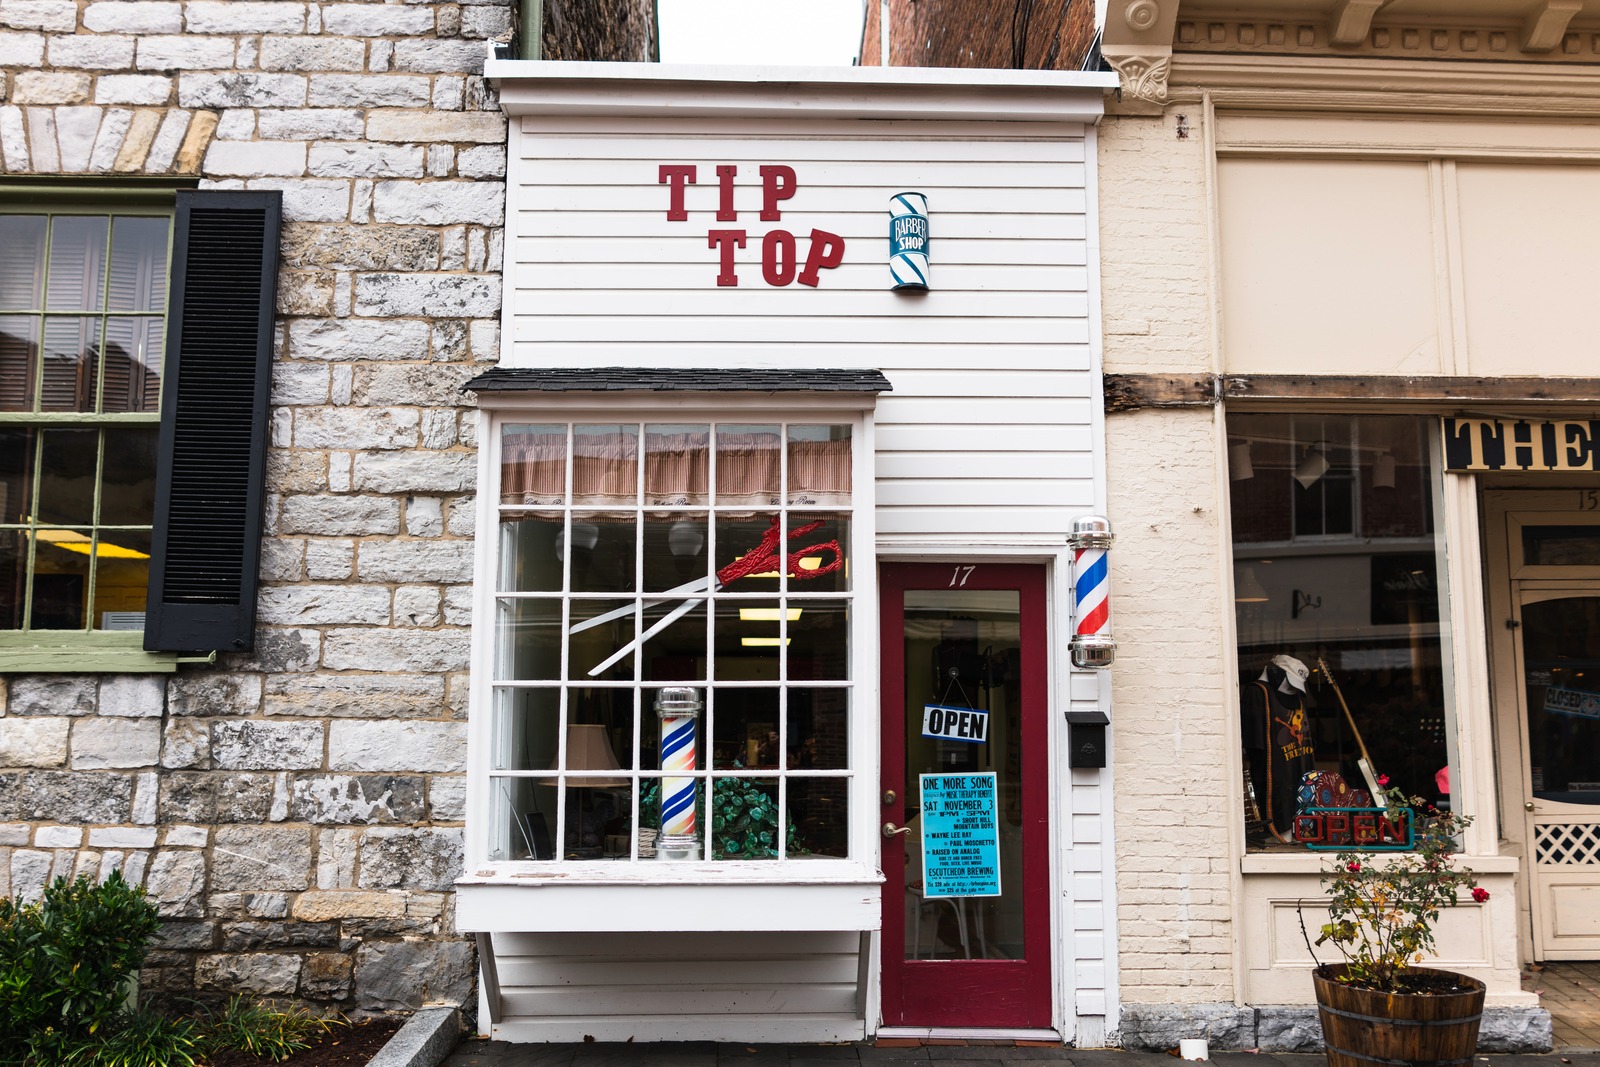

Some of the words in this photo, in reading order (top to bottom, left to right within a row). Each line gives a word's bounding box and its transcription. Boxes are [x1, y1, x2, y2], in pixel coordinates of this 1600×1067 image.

[659, 165, 797, 221] TIP
[895, 217, 927, 242] BARBER
[899, 236, 924, 250] SHOP
[708, 228, 846, 287] TOP
[1455, 418, 1593, 470] THE
[1579, 491, 1598, 510] 15
[949, 565, 976, 587] 17
[1546, 688, 1581, 708] CLOSED
[928, 709, 985, 739] OPEN
[923, 778, 939, 790] ONE
[943, 778, 966, 790] MORE
[971, 777, 992, 789] SONG
[946, 790, 958, 798] MUSIC
[958, 790, 976, 798] THERAPY
[977, 789, 992, 798] BENEFIT
[924, 801, 938, 811] SAT
[944, 800, 982, 811] NOVEMBER
[989, 799, 993, 810] 3
[1295, 815, 1405, 842] OPEN
[928, 867, 966, 877] ESCUTCHEON
[967, 866, 994, 876] BREWING
